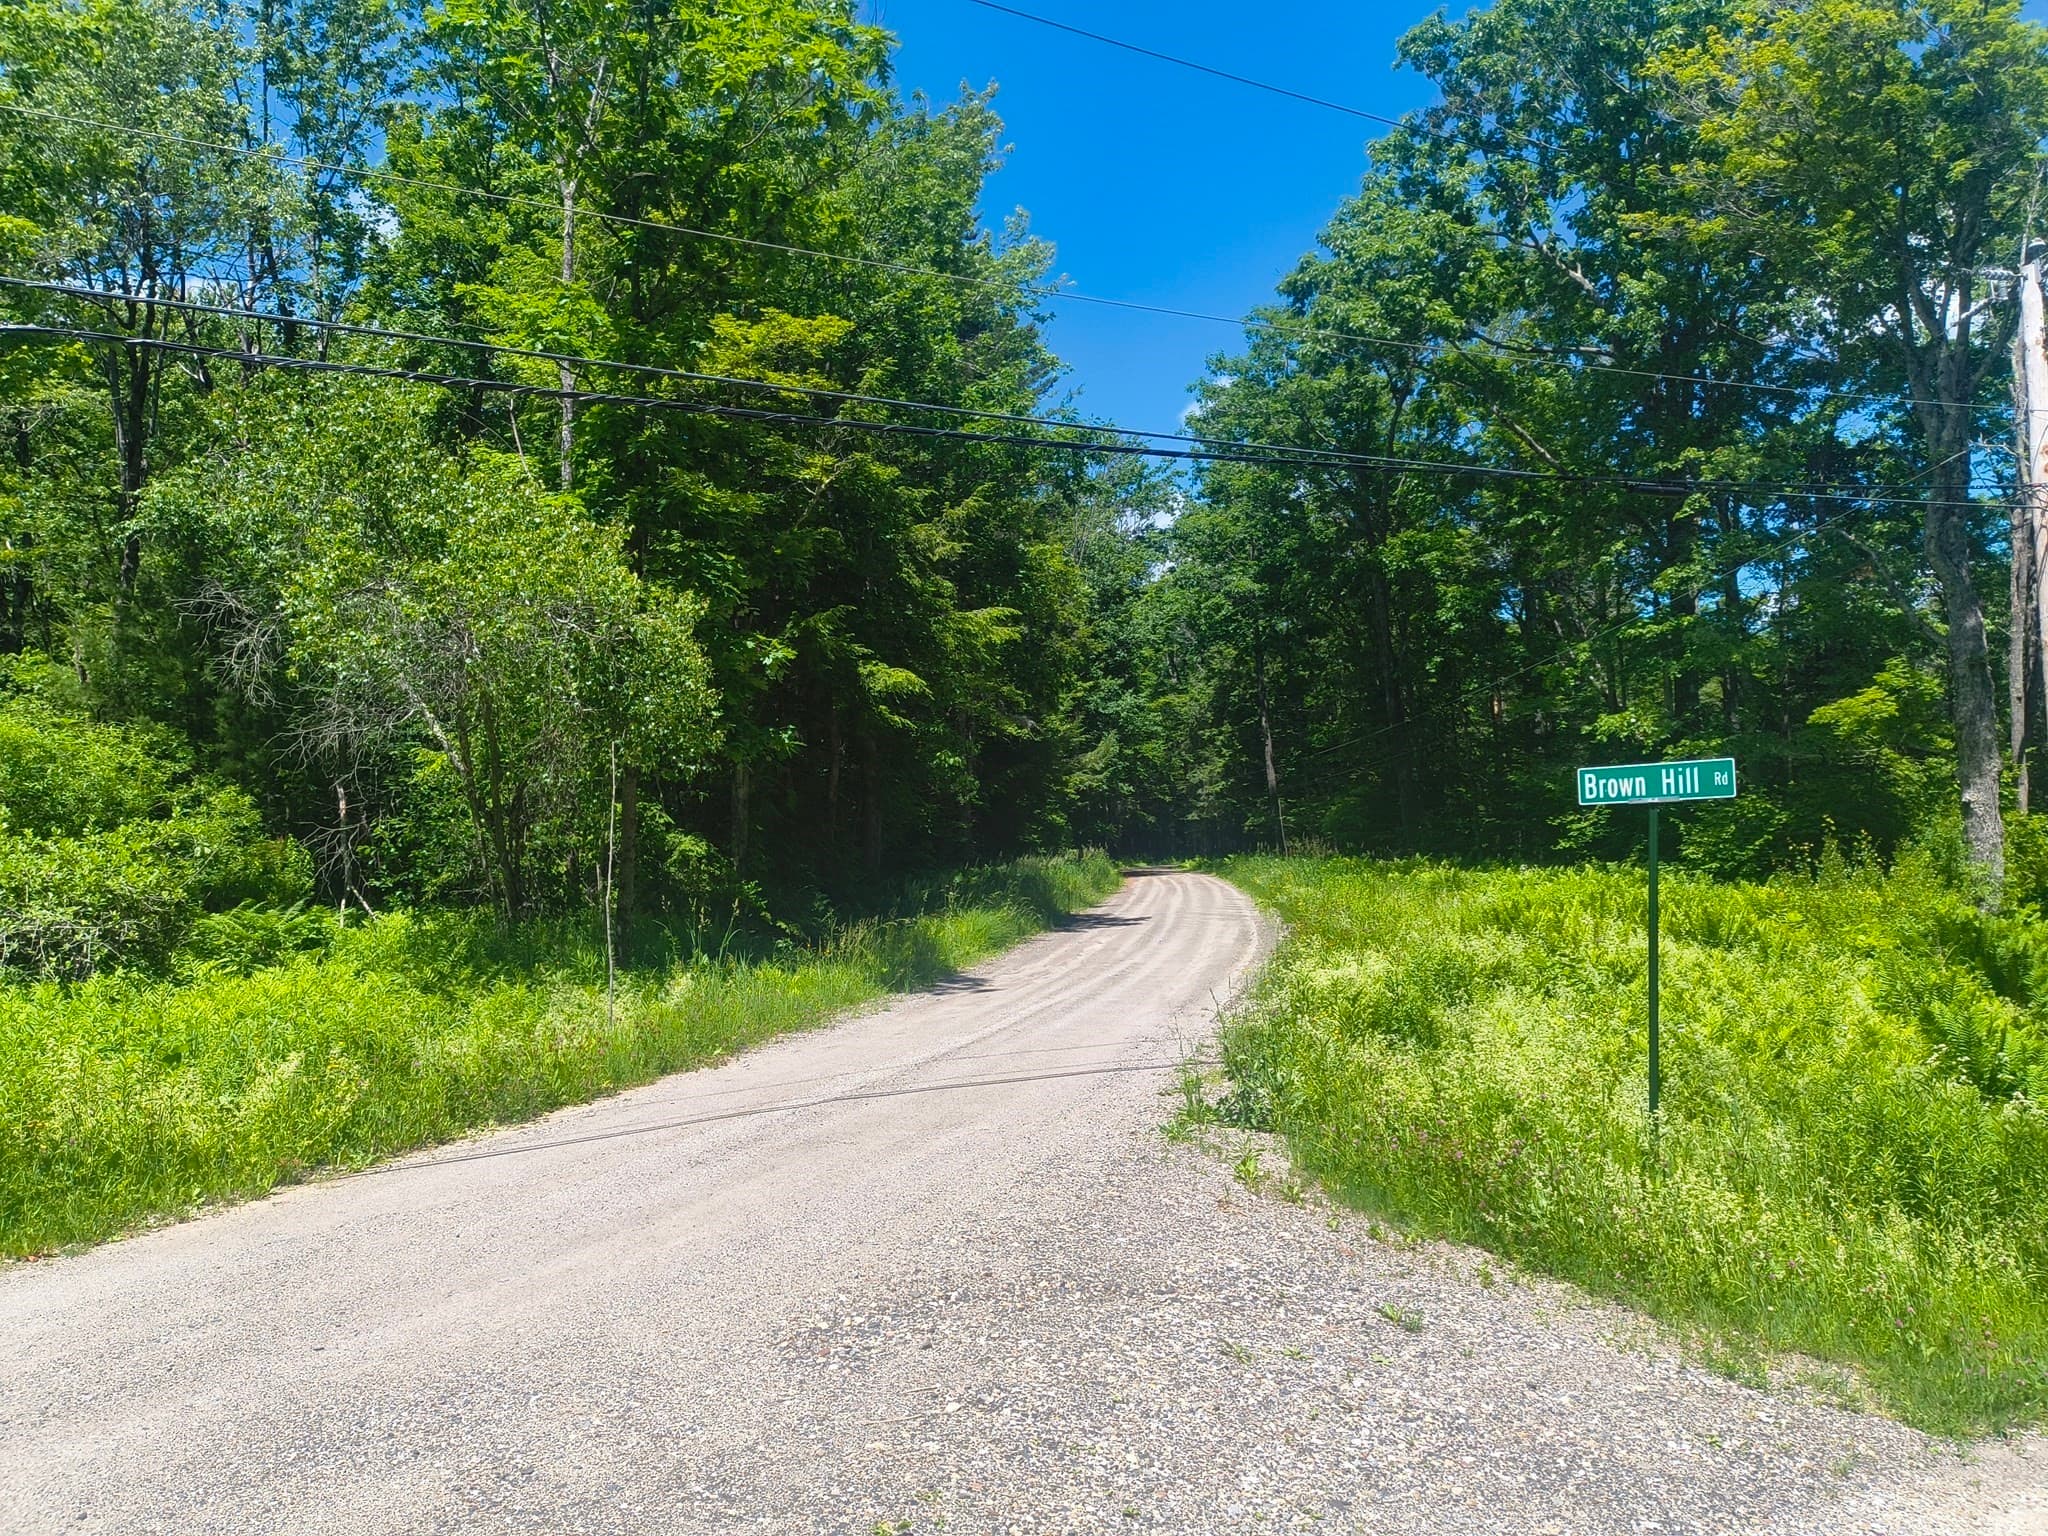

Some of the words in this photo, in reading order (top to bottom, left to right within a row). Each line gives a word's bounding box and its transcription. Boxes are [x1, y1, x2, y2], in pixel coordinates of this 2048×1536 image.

[1584, 773, 1646, 799] Brown
[1661, 767, 1699, 795] Hill
[1714, 771, 1728, 786] Rd
